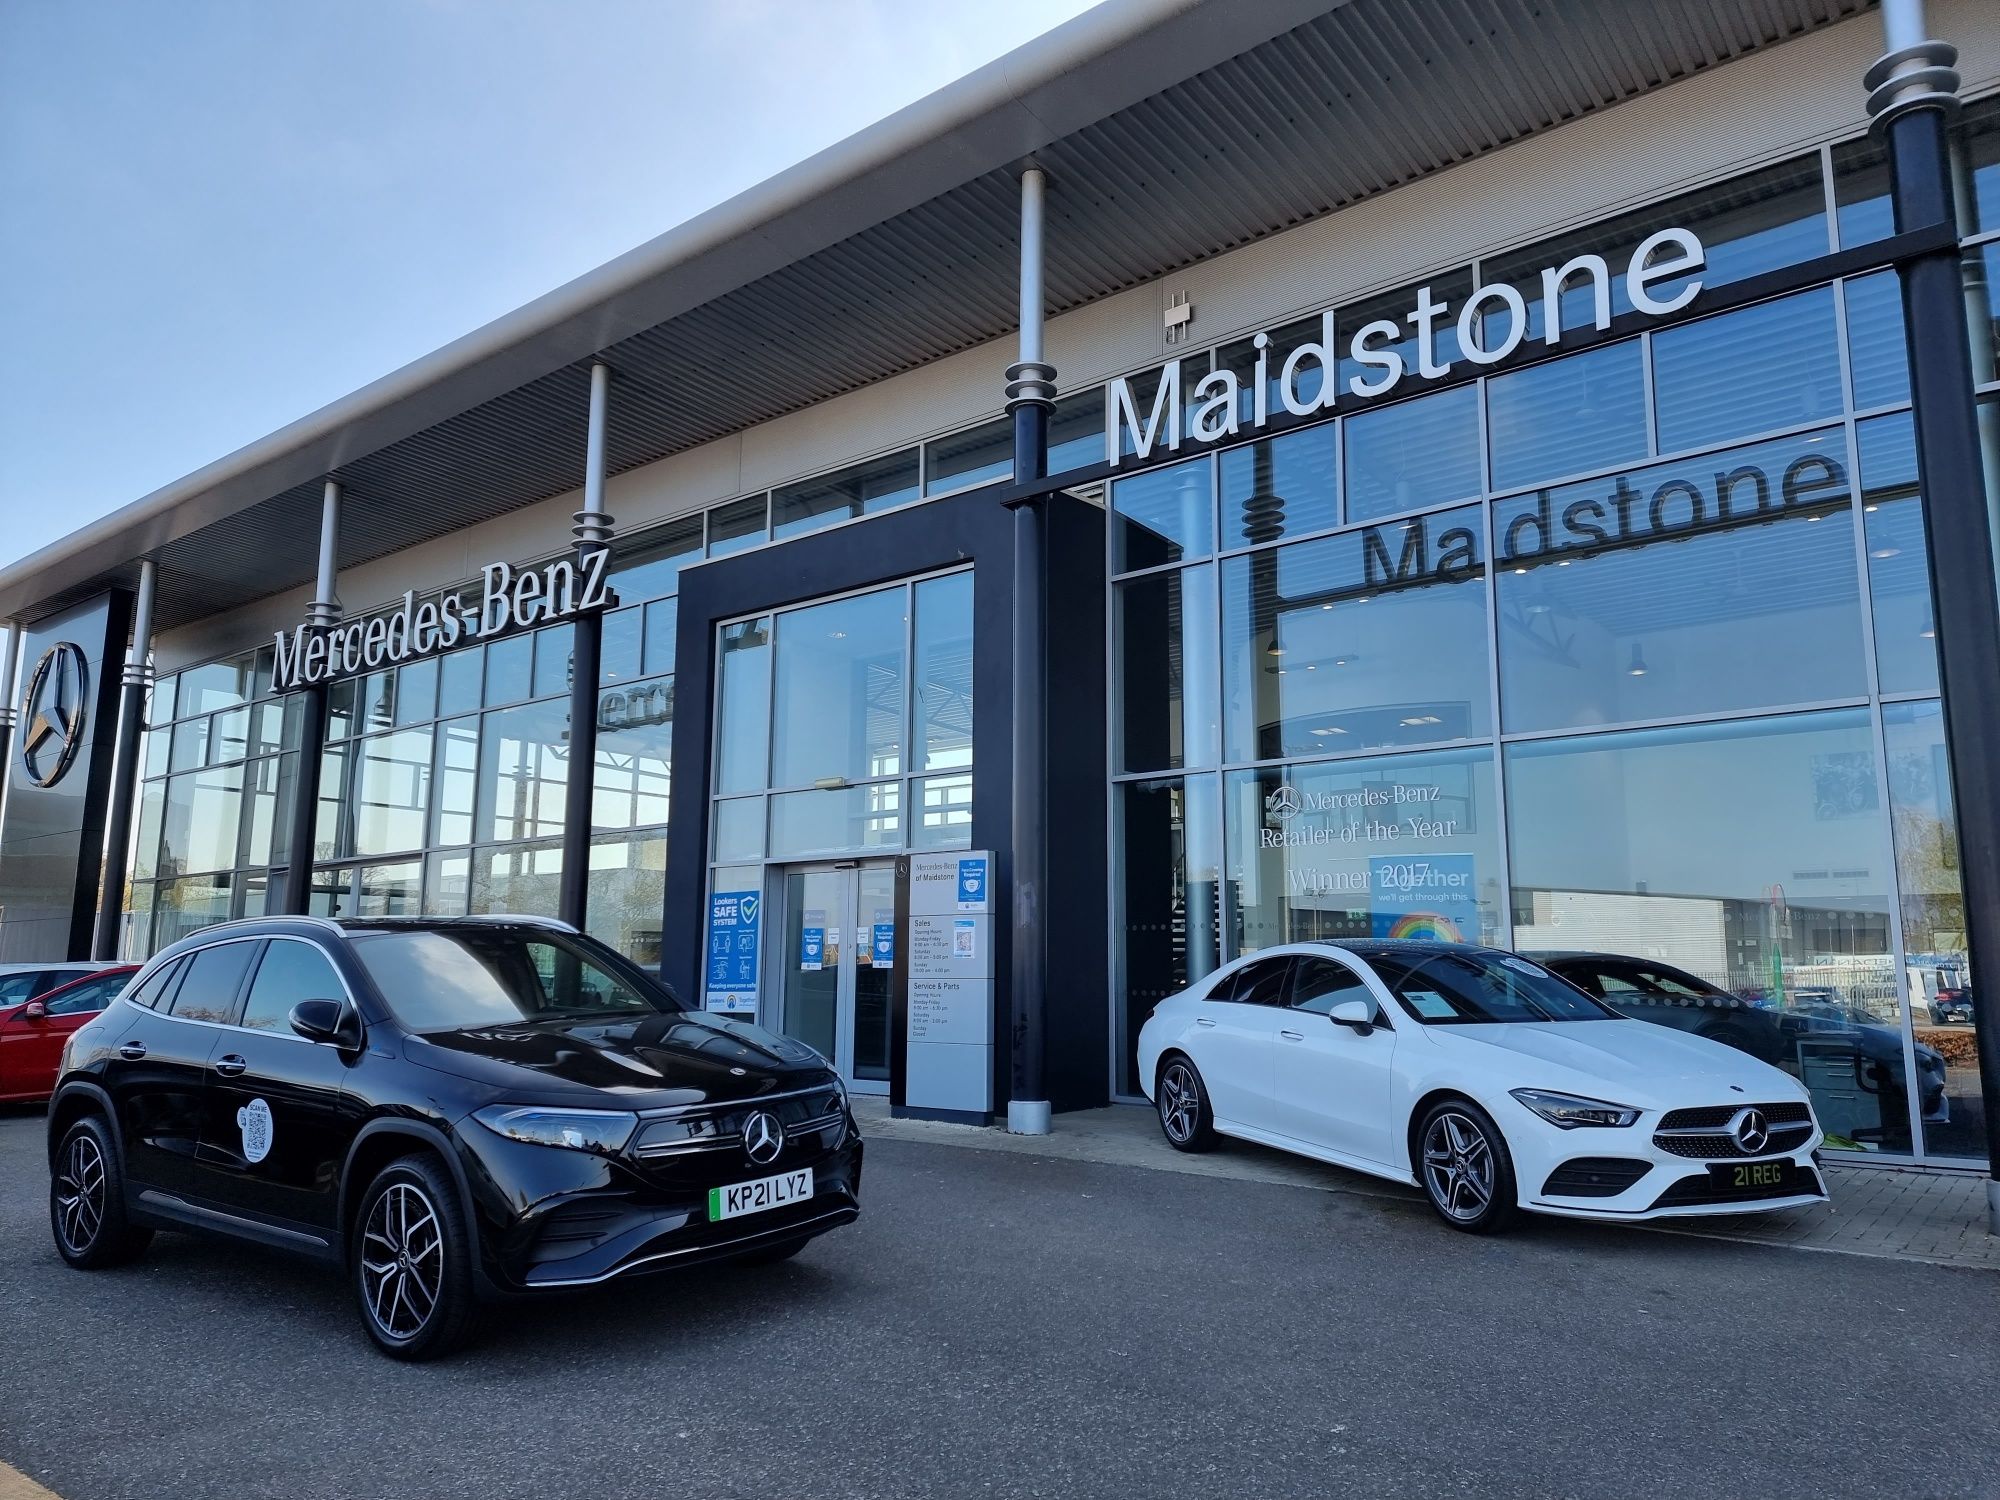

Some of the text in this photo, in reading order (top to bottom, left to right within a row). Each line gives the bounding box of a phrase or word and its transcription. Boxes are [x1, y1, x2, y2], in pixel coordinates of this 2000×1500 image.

[1109, 227, 1707, 468] Maidstone
[1361, 453, 1849, 585] Madstone
[268, 548, 611, 693] Mercedes-Benz
[1306, 785, 1441, 811] Mercedes-Benz
[1260, 817, 1457, 849] Retailer of the Year
[916, 862, 957, 871] Mercedes-Benz
[923, 873, 955, 881] Maidstone
[1288, 863, 1430, 892] Winner 2017
[714, 897, 738, 906] Lookers
[1378, 892, 1468, 902] we'll get through this
[713, 906, 738, 917] SAFE
[713, 918, 738, 926] SYSTEM
[914, 982, 960, 990] Service & Parts
[250, 1104, 260, 1112] SCAN
[1734, 1164, 1781, 1186] 21 REG
[728, 1173, 807, 1213] KP21 LYZ
